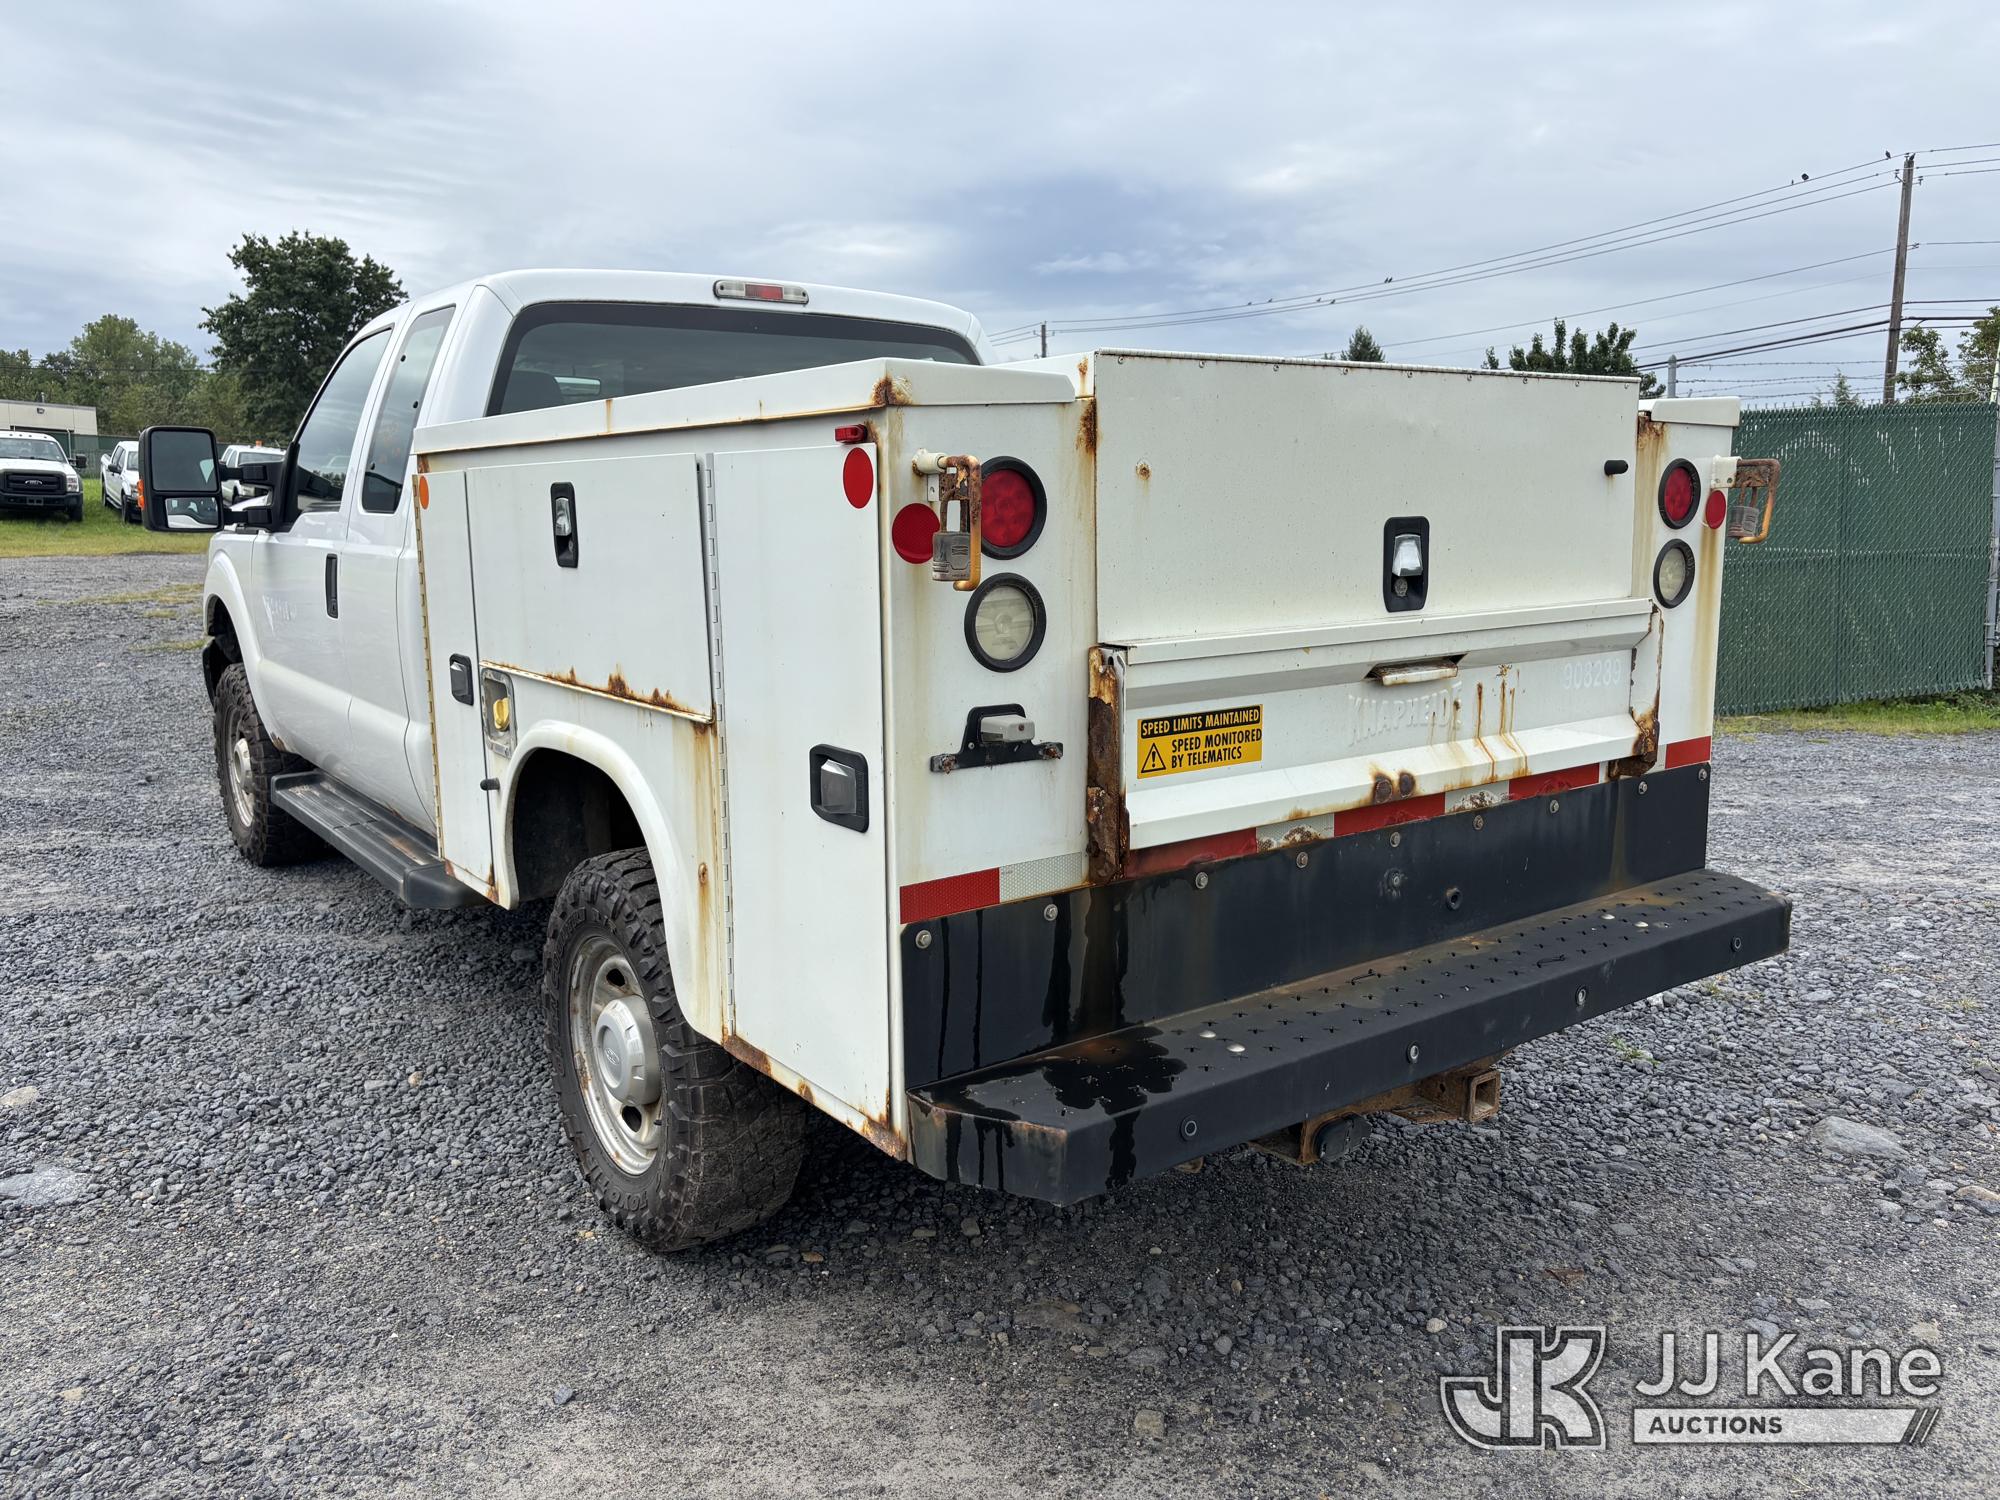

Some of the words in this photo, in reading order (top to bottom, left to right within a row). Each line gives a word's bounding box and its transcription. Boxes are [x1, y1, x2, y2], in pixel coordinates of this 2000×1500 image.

[1562, 658, 1622, 690] 908289
[1142, 720, 1170, 736] SPEED
[1173, 715, 1203, 732] LIMITS
[1205, 709, 1260, 728] MAINTAINED
[1172, 736, 1201, 753] SPEED
[1204, 728, 1262, 749] MONITORED
[1171, 753, 1184, 769] BY
[1187, 746, 1242, 767] TELEMATICS
